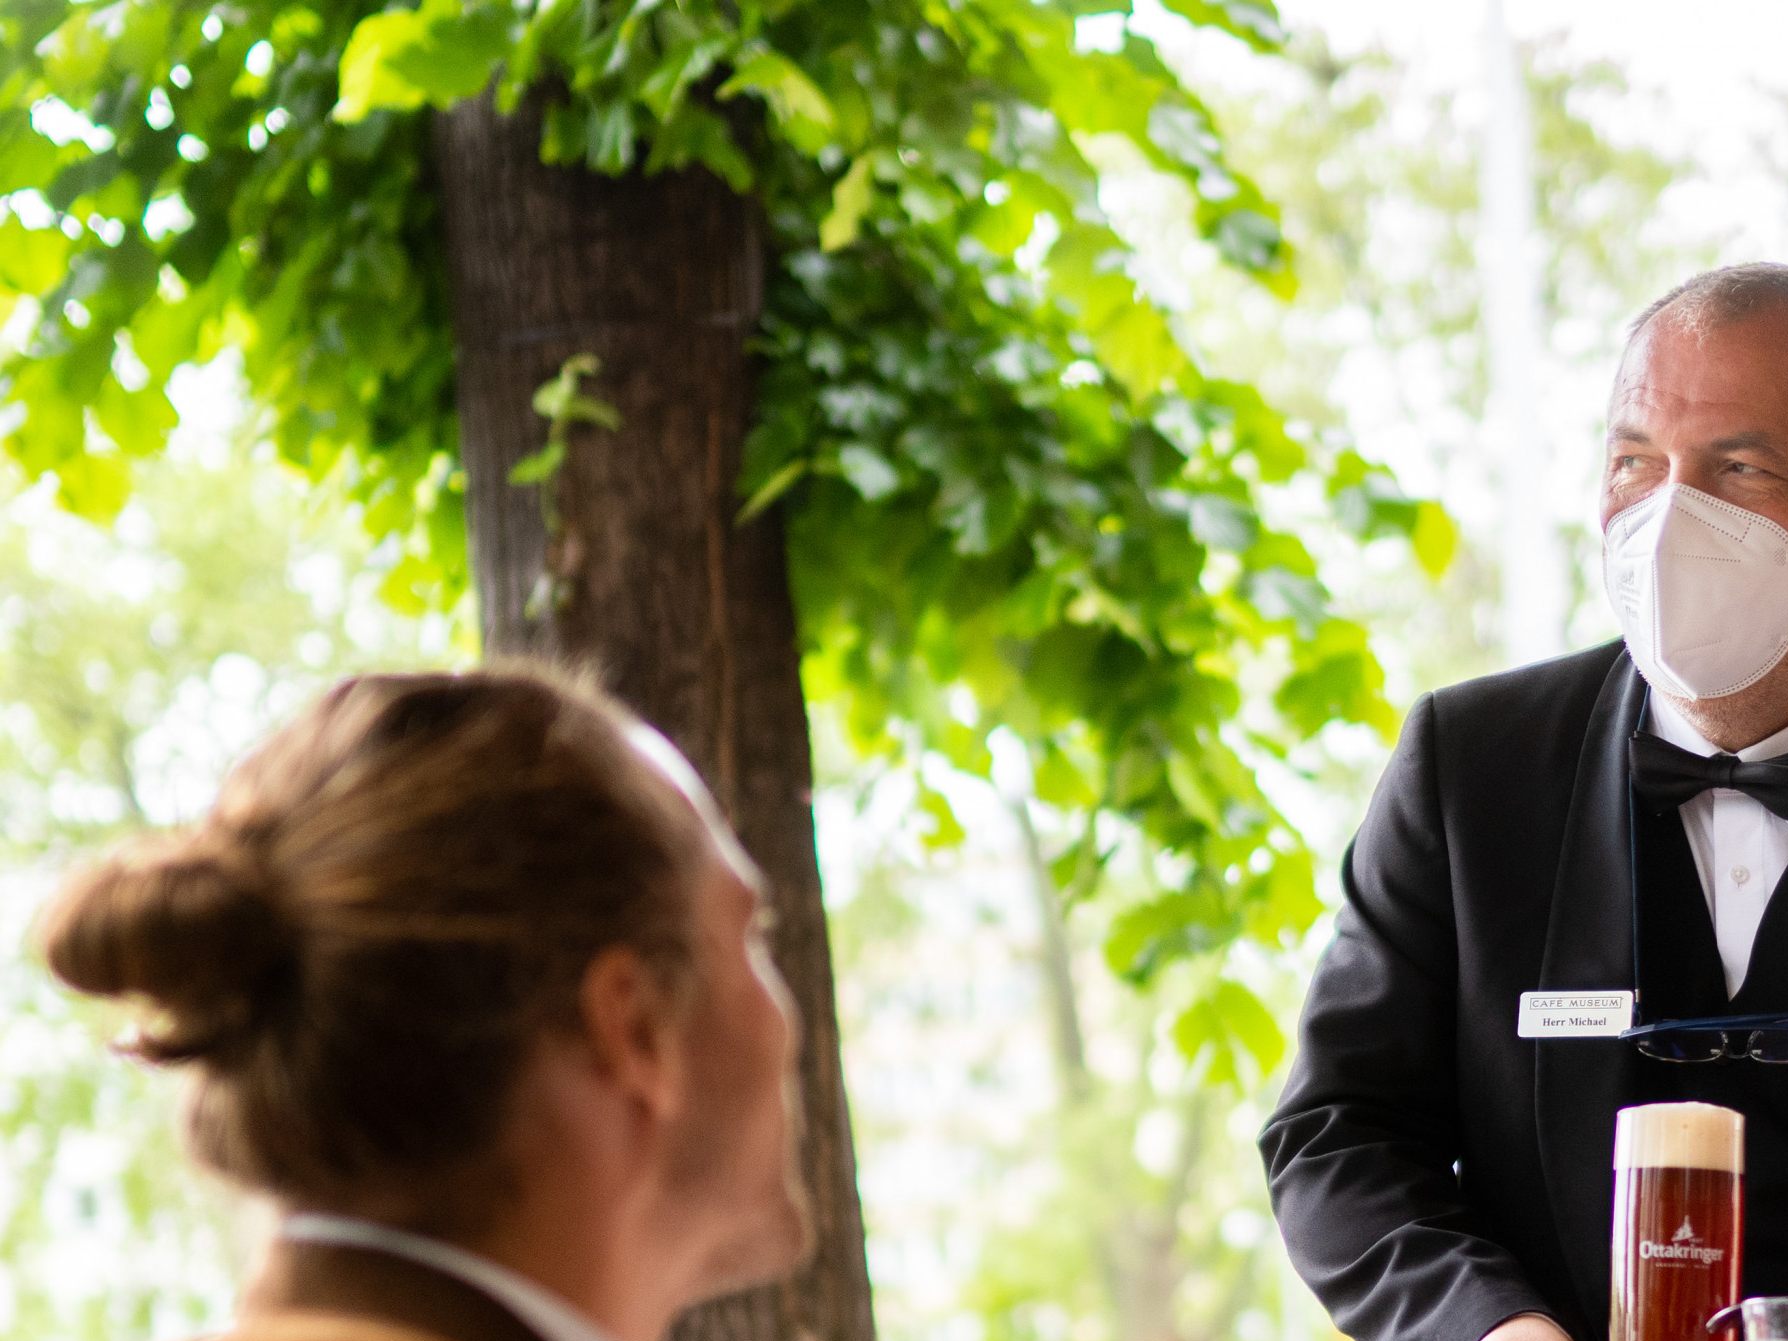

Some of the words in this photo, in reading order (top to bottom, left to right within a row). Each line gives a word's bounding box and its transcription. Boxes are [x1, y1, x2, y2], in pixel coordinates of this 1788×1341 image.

[1569, 999, 1619, 1008] MUSEUM
[1542, 1017, 1566, 1027] Herr
[1569, 1017, 1607, 1026] Michael
[1639, 1240, 1724, 1265] Ottakringer
